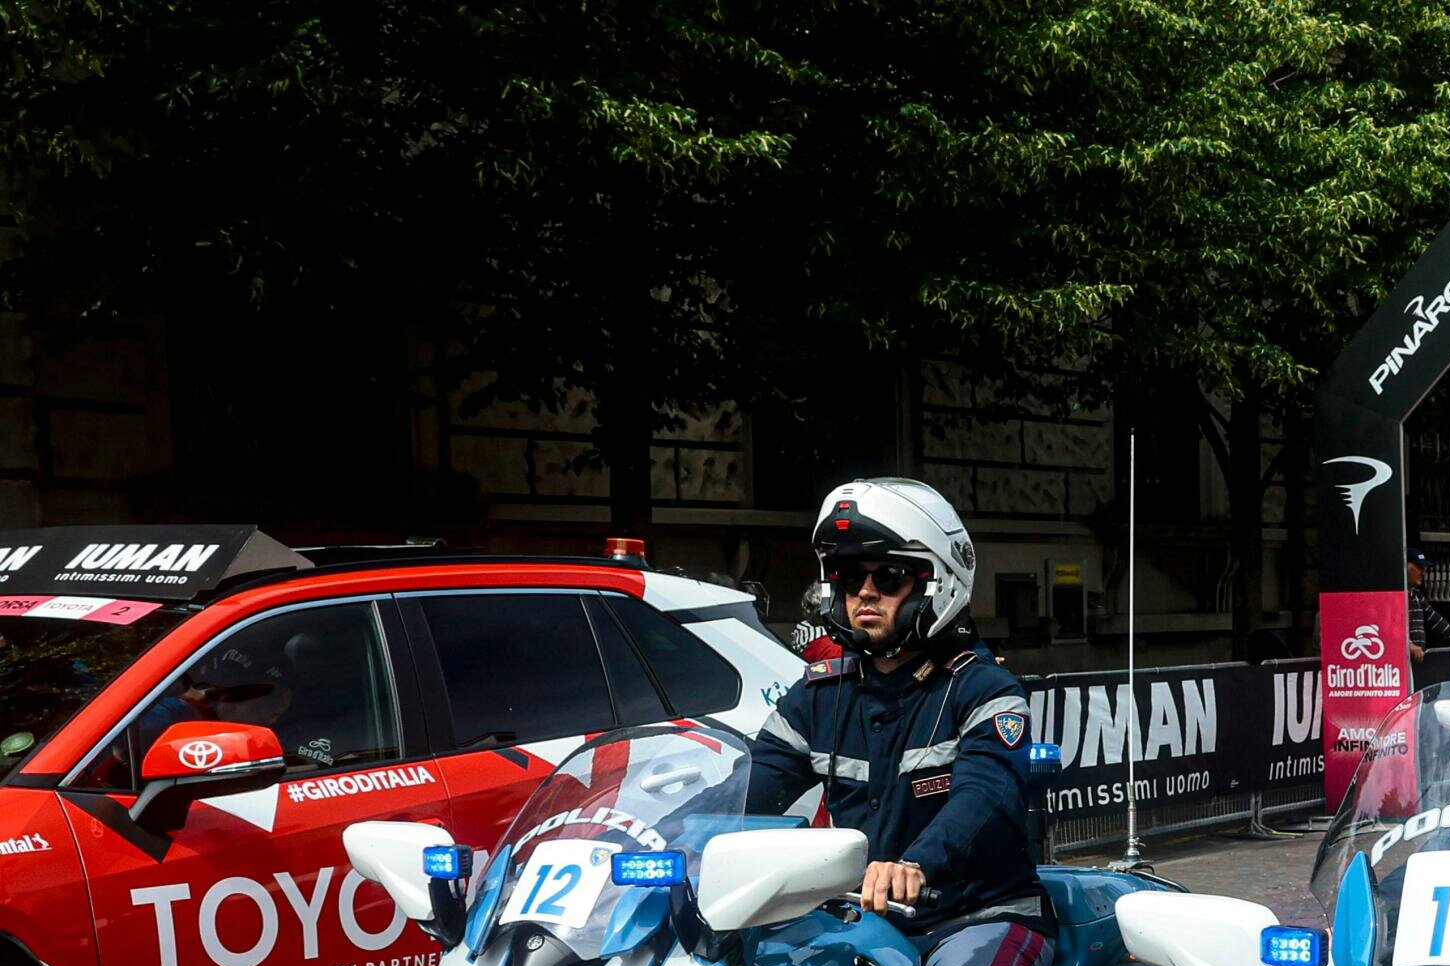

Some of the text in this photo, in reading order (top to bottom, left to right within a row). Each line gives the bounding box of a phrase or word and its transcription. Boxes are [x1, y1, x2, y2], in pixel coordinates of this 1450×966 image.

[64, 543, 219, 572] IUMAN
[54, 571, 188, 584] intimissimi uomo
[43, 601, 94, 611] TOYOTA
[111, 606, 130, 616] 2
[1327, 663, 1400, 688] Giro d'Italia
[1029, 678, 1217, 770] IUMAN
[286, 765, 436, 803] #GIRODITALIA
[914, 777, 951, 793] POLIZIA
[1046, 770, 1210, 813] timissimi uomo
[511, 807, 667, 857] POLIZIA
[519, 864, 582, 916] 12
